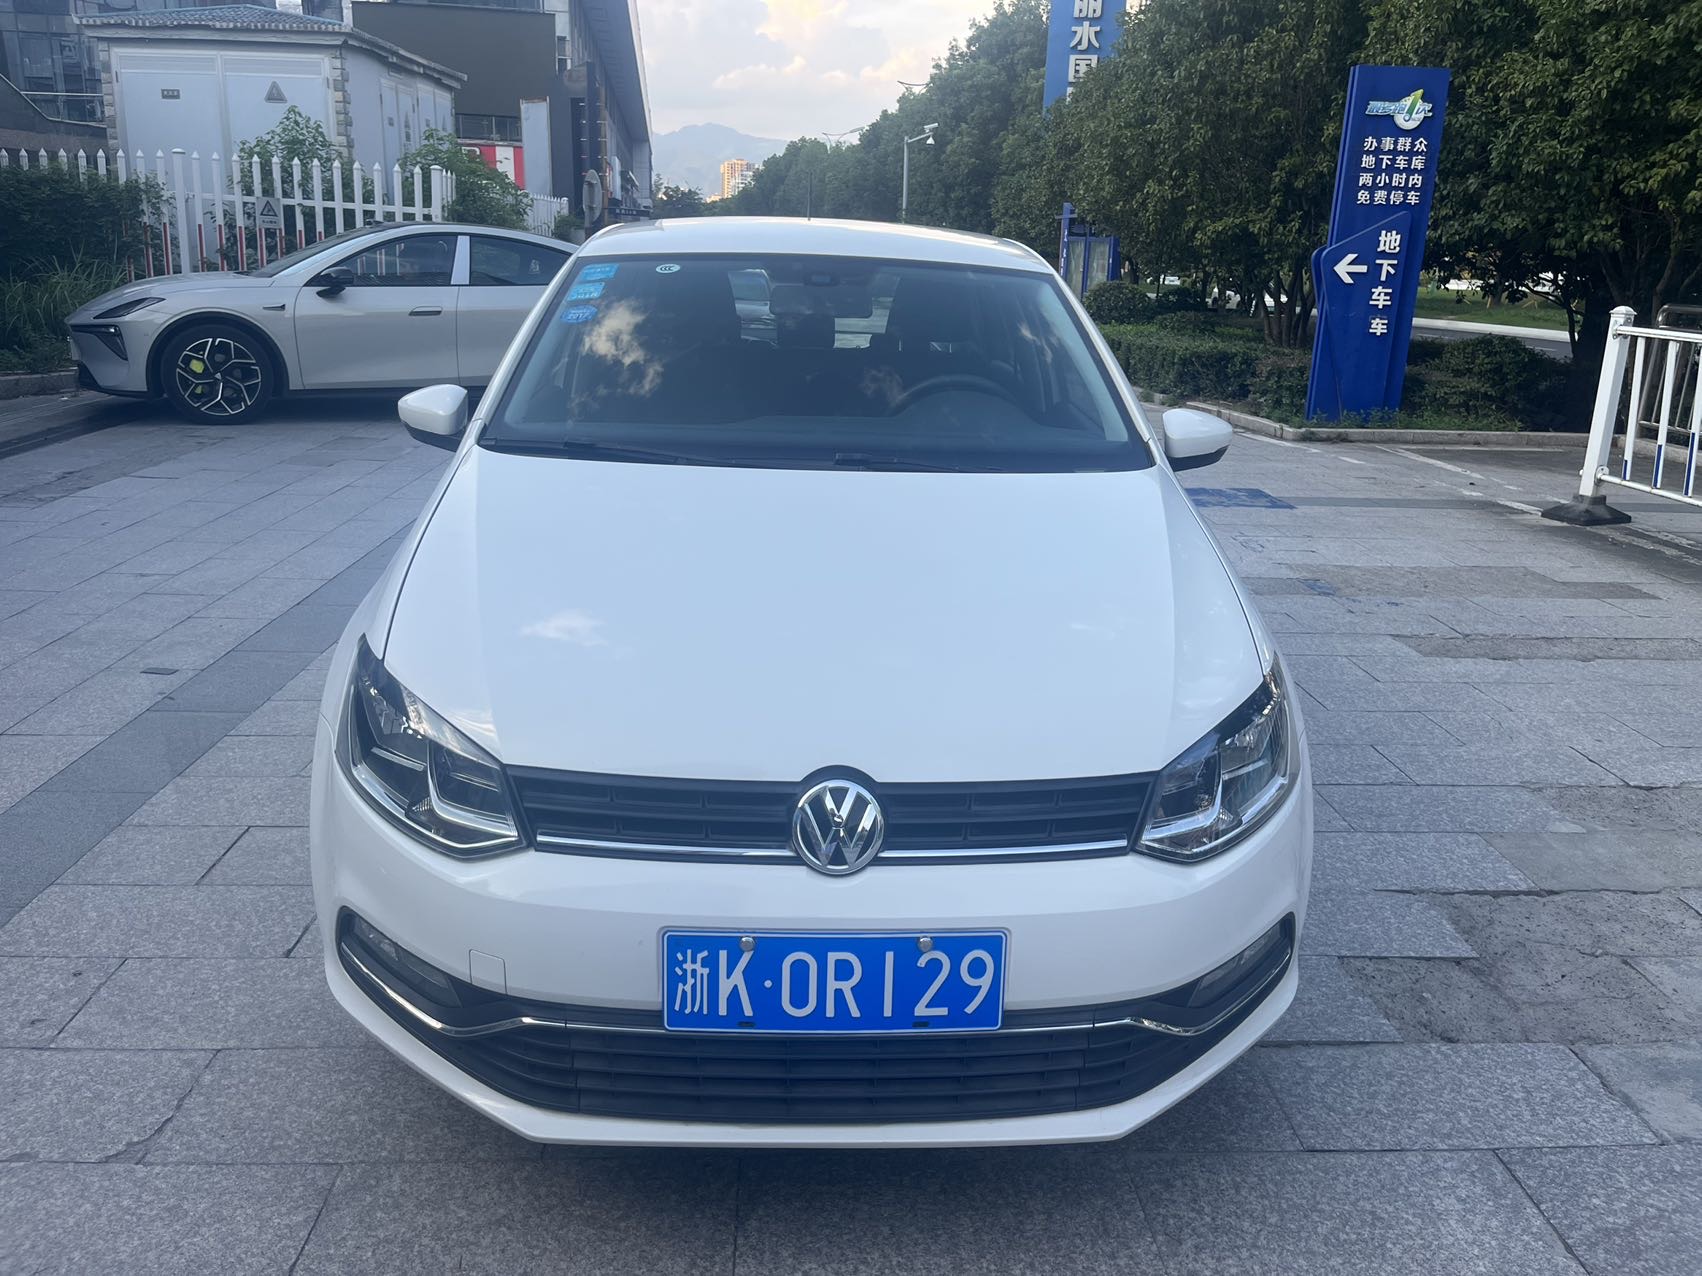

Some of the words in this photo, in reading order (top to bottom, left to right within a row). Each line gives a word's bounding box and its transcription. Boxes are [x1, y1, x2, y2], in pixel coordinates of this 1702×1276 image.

[1066, 0, 1103, 105] 丽水国
[1363, 136, 1428, 152] 办事群众
[1360, 154, 1427, 170] 地下车库
[1358, 172, 1423, 188] 两小时内
[1356, 189, 1421, 206] 免费停车
